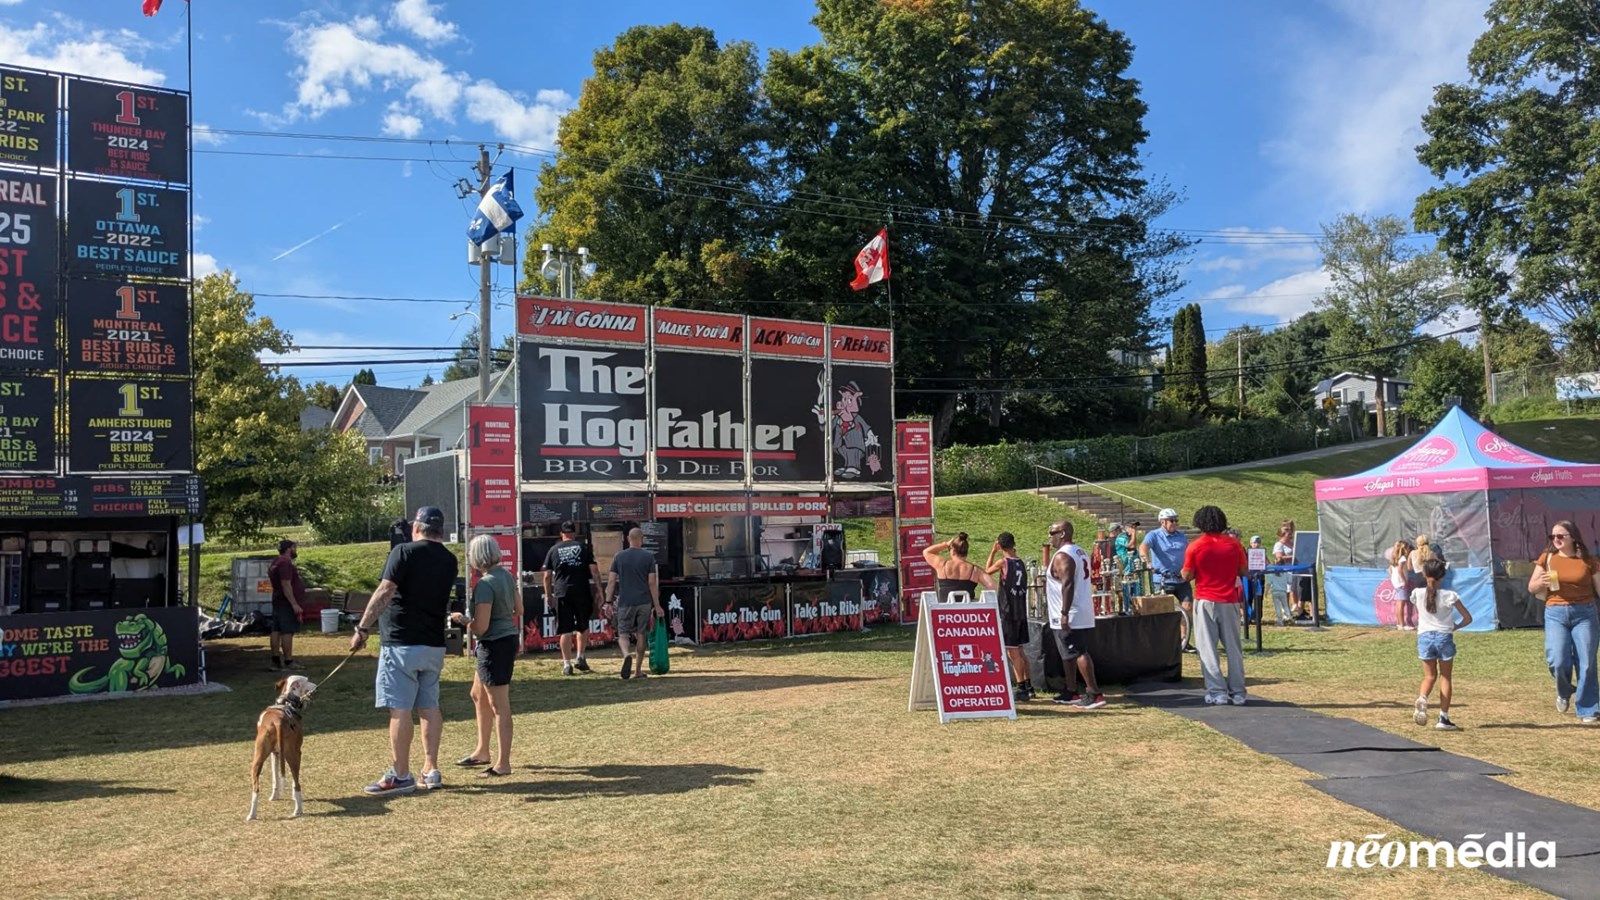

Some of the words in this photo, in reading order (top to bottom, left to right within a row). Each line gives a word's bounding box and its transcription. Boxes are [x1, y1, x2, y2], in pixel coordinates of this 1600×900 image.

[4, 76, 29, 92] ST.
[116, 91, 140, 125] 1
[137, 96, 159, 110] ST.
[8, 109, 45, 123] PARK
[92, 122, 142, 137] THUNDER
[145, 129, 166, 140] BAY
[0, 134, 39, 151] RIBS
[108, 136, 148, 150] 2024
[108, 148, 128, 159] BEST
[120, 160, 148, 171] SAUCE
[0, 180, 47, 205] REAL
[116, 188, 140, 222] 1
[137, 192, 160, 207] ST.
[0, 212, 31, 244] 25
[96, 220, 161, 235] OTTAWA
[107, 233, 151, 247] 2022
[77, 245, 121, 260] BEST
[124, 247, 179, 265] SAUCE
[135, 265, 163, 274] CHOICE
[18, 282, 42, 311] &
[116, 286, 141, 319] 1
[137, 290, 160, 304] ST.
[93, 319, 164, 332] MONTREAL
[575, 311, 637, 331] GONNA
[657, 321, 691, 335] MAKE
[719, 327, 729, 339] A
[843, 337, 886, 354] REFUSE
[107, 329, 151, 342] 2021
[0, 348, 45, 360] CHOICE
[82, 339, 121, 351] BEST
[125, 340, 160, 354] RIBS
[164, 344, 175, 355] &
[82, 351, 121, 363] BEST
[126, 352, 176, 365] SAUCE
[539, 347, 645, 394] The
[1, 382, 25, 396] ST.
[119, 383, 143, 416] 1
[140, 386, 163, 400] ST.
[12, 417, 39, 427] BAY
[88, 418, 172, 428] AMHERSTBURG
[110, 430, 154, 442] 2024
[540, 403, 807, 457] Hogfather
[25, 440, 37, 450] &
[110, 443, 132, 452] BEST
[134, 443, 154, 452] RIBS
[123, 453, 150, 462] SAUCE
[543, 459, 613, 476] BBQ
[93, 484, 125, 492] RIBS
[1396, 477, 1420, 488] Fluffs
[93, 503, 144, 511] CHICKEN
[656, 503, 687, 513] RIBS
[694, 502, 746, 512] CHICKEN
[752, 502, 793, 511] PULLED
[797, 501, 827, 511] PORK
[1016, 570, 1023, 586] 7
[707, 609, 738, 625] Leave
[739, 607, 758, 622] The
[760, 606, 781, 622] Gun
[794, 603, 818, 620] Take
[819, 601, 837, 617] The
[839, 600, 860, 615] Ribs
[938, 613, 990, 623] PROUDLY
[44, 625, 94, 639] TASTE
[937, 627, 995, 637] CANADIAN
[21, 641, 73, 656] WE'RE
[78, 639, 110, 652] THE
[940, 651, 953, 661] The
[942, 661, 983, 677] Hogfather
[944, 685, 981, 695] OWNED
[984, 684, 1005, 694] AND
[949, 697, 1004, 707] OPERATED
